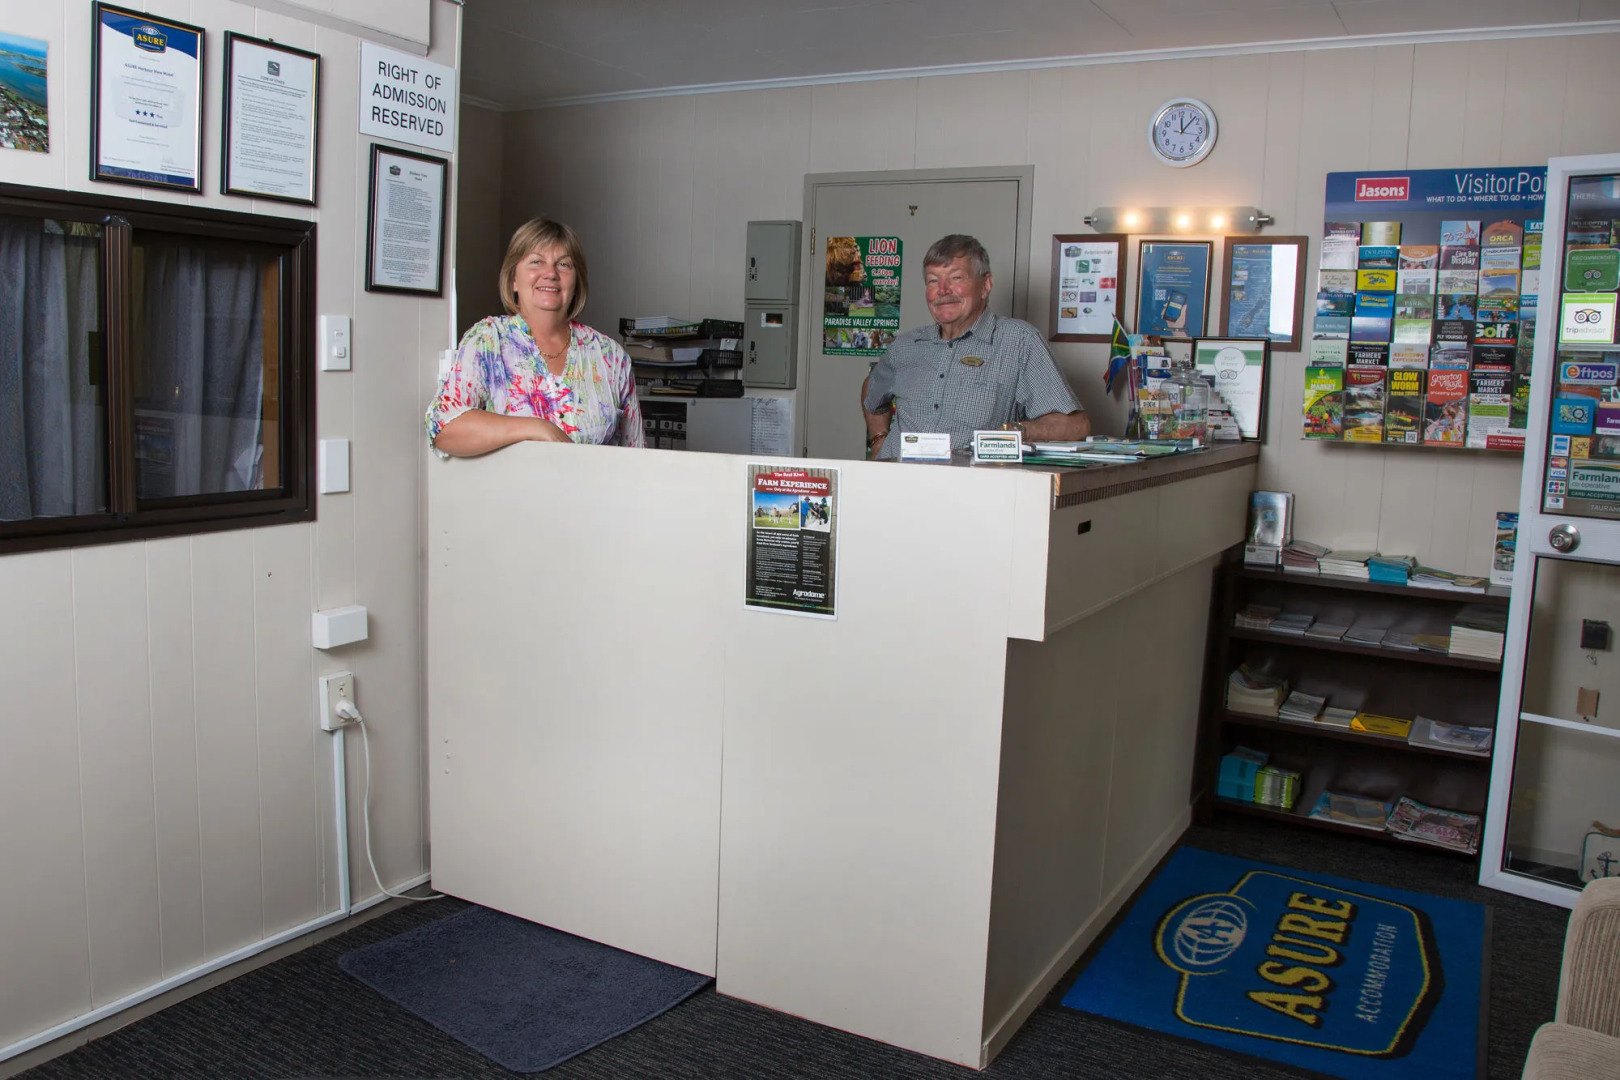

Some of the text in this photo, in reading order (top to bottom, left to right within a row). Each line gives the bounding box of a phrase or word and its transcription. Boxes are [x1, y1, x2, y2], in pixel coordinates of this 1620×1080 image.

[137, 34, 164, 46] ASURE
[379, 61, 441, 90] RIGHT OF
[372, 82, 446, 114] ADMISSION
[372, 105, 444, 136] RESERVED
[1359, 184, 1405, 197] Jasons
[869, 238, 898, 254] LION
[865, 254, 900, 266] FEEDING
[1452, 256, 1476, 265] Display
[824, 317, 898, 327] PARADISE VALLEY SPRINGS
[1393, 372, 1418, 381] GLOW
[1567, 365, 1613, 380] eftpos
[1391, 381, 1420, 390] WORM
[980, 441, 1016, 449] Farmlands
[1572, 472, 1620, 483] Farmlan
[758, 478, 827, 490] FARM EXPERIENCE
[793, 589, 825, 599] Agrodome
[1248, 892, 1352, 1025] ASURE
[1355, 923, 1398, 1025] ACCOMMODATION
